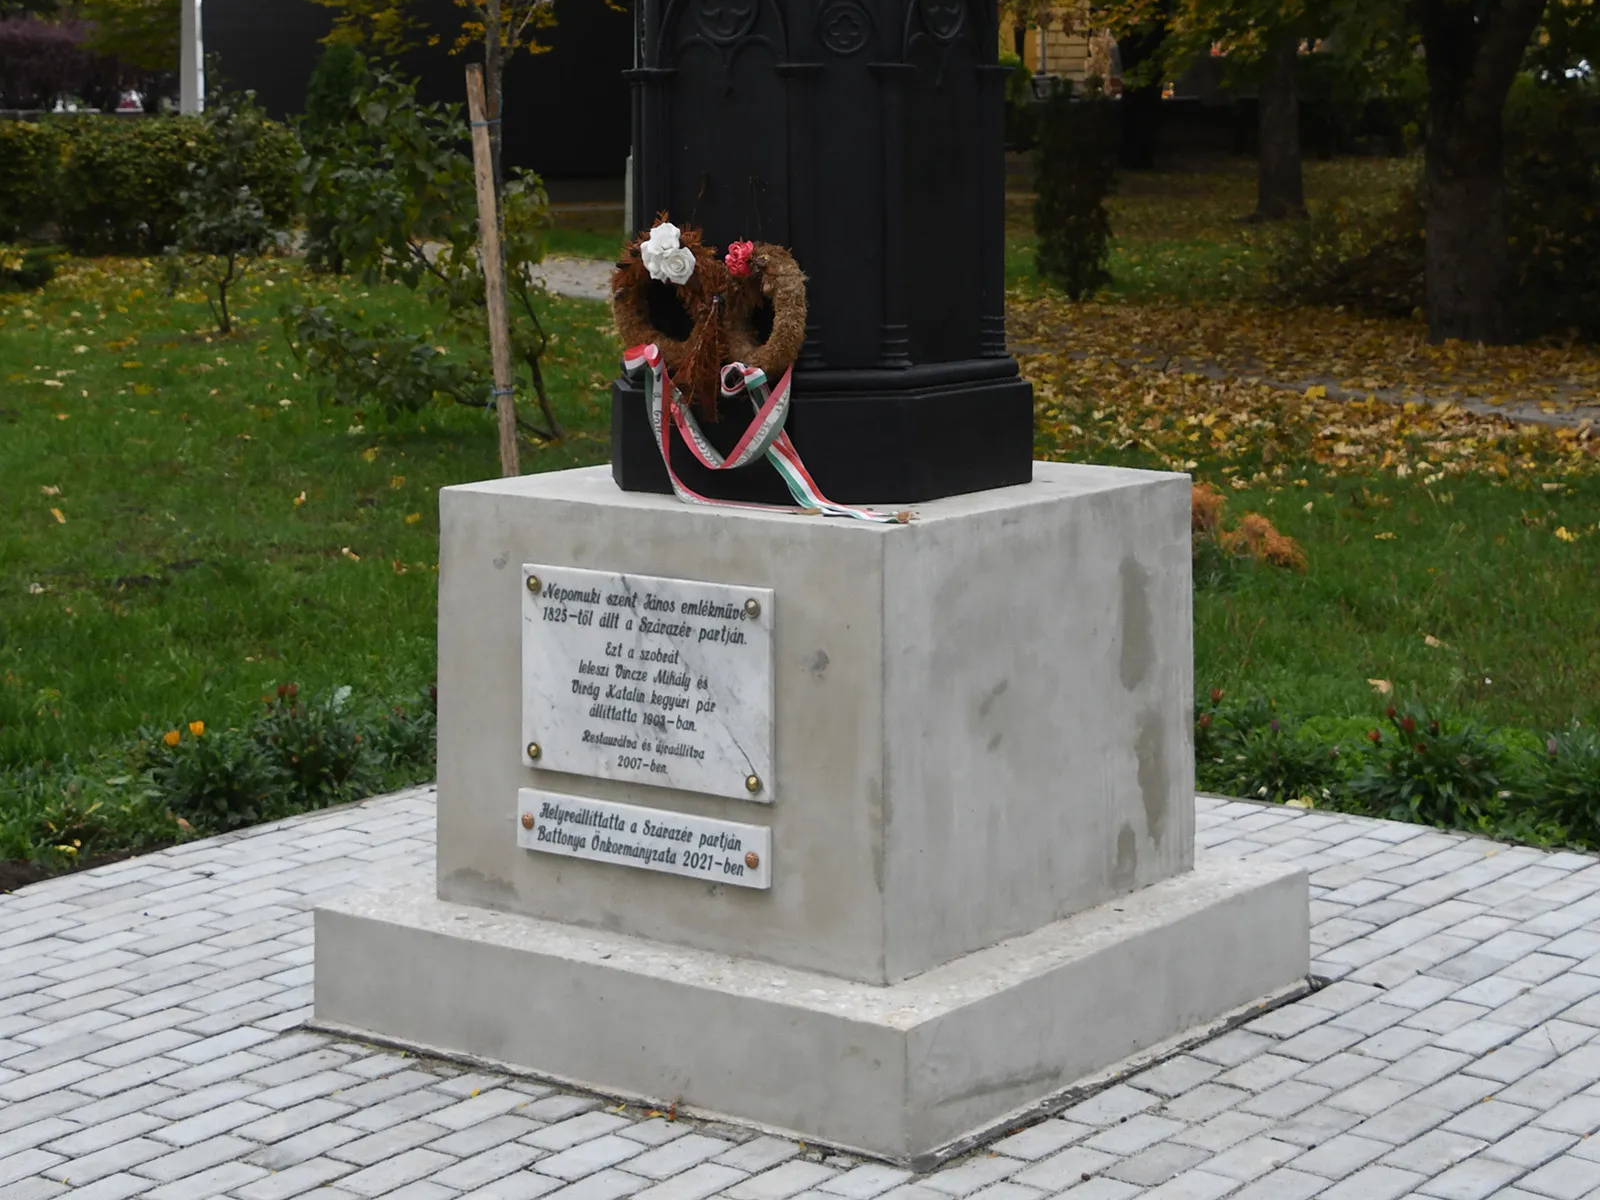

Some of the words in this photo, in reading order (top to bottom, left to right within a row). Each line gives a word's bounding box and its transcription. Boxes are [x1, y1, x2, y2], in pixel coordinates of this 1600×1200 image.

[542, 581, 602, 604] Nepomuki
[606, 592, 638, 608] szent
[643, 593, 676, 612] János
[542, 606, 594, 626] 1825-től
[599, 612, 620, 629] állt
[625, 619, 633, 631] a
[639, 616, 692, 638] Szárazér
[698, 625, 747, 646] partján.
[605, 641, 623, 658] Ezt
[627, 648, 635, 659] a
[639, 647, 679, 664] szobrát
[578, 659, 610, 677] leleszi
[615, 663, 648, 682] Vincze
[653, 668, 692, 692] Mihály
[697, 674, 709, 690] és
[571, 679, 600, 701] Virág
[605, 684, 645, 703] Katalin
[650, 689, 690, 711] kegyúri
[696, 697, 716, 713] pár
[581, 729, 637, 750] Restaurálva
[641, 737, 652, 751] és
[617, 754, 668, 774] 2007-ben.
[537, 824, 587, 852] Battonya
[591, 829, 677, 864] Önkormányzata
[682, 850, 745, 877] 2021-ben
[630, 821, 638, 833] a
[642, 819, 693, 843] Szárazér
[698, 831, 742, 852] partján
